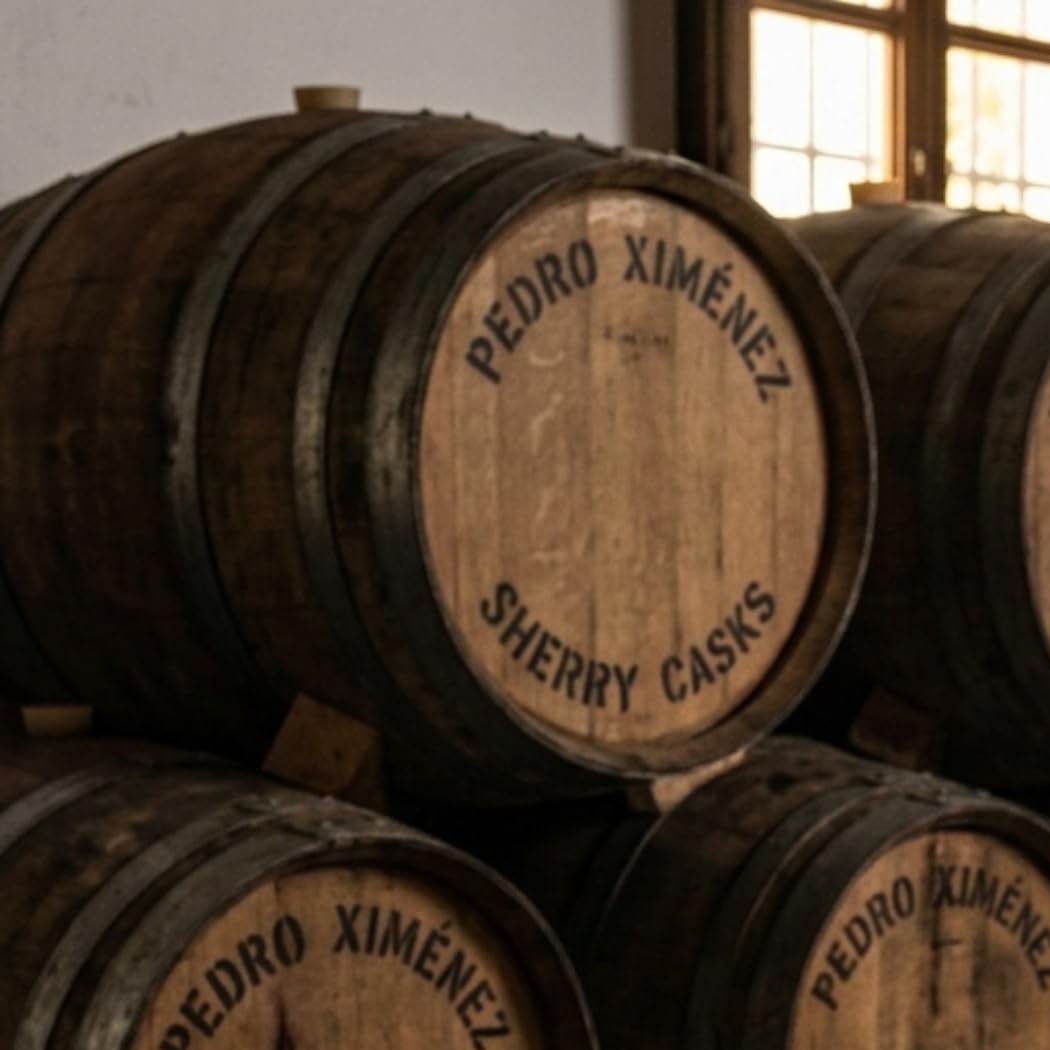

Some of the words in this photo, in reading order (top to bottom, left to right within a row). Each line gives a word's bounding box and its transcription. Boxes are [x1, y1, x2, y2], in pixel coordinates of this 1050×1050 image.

[465, 239, 599, 384] PEDRO
[623, 234, 793, 403] XIMÉNEZ
[480, 582, 638, 713] SHERRY
[661, 580, 777, 703] CASKS
[810, 876, 916, 1011] PEDRO
